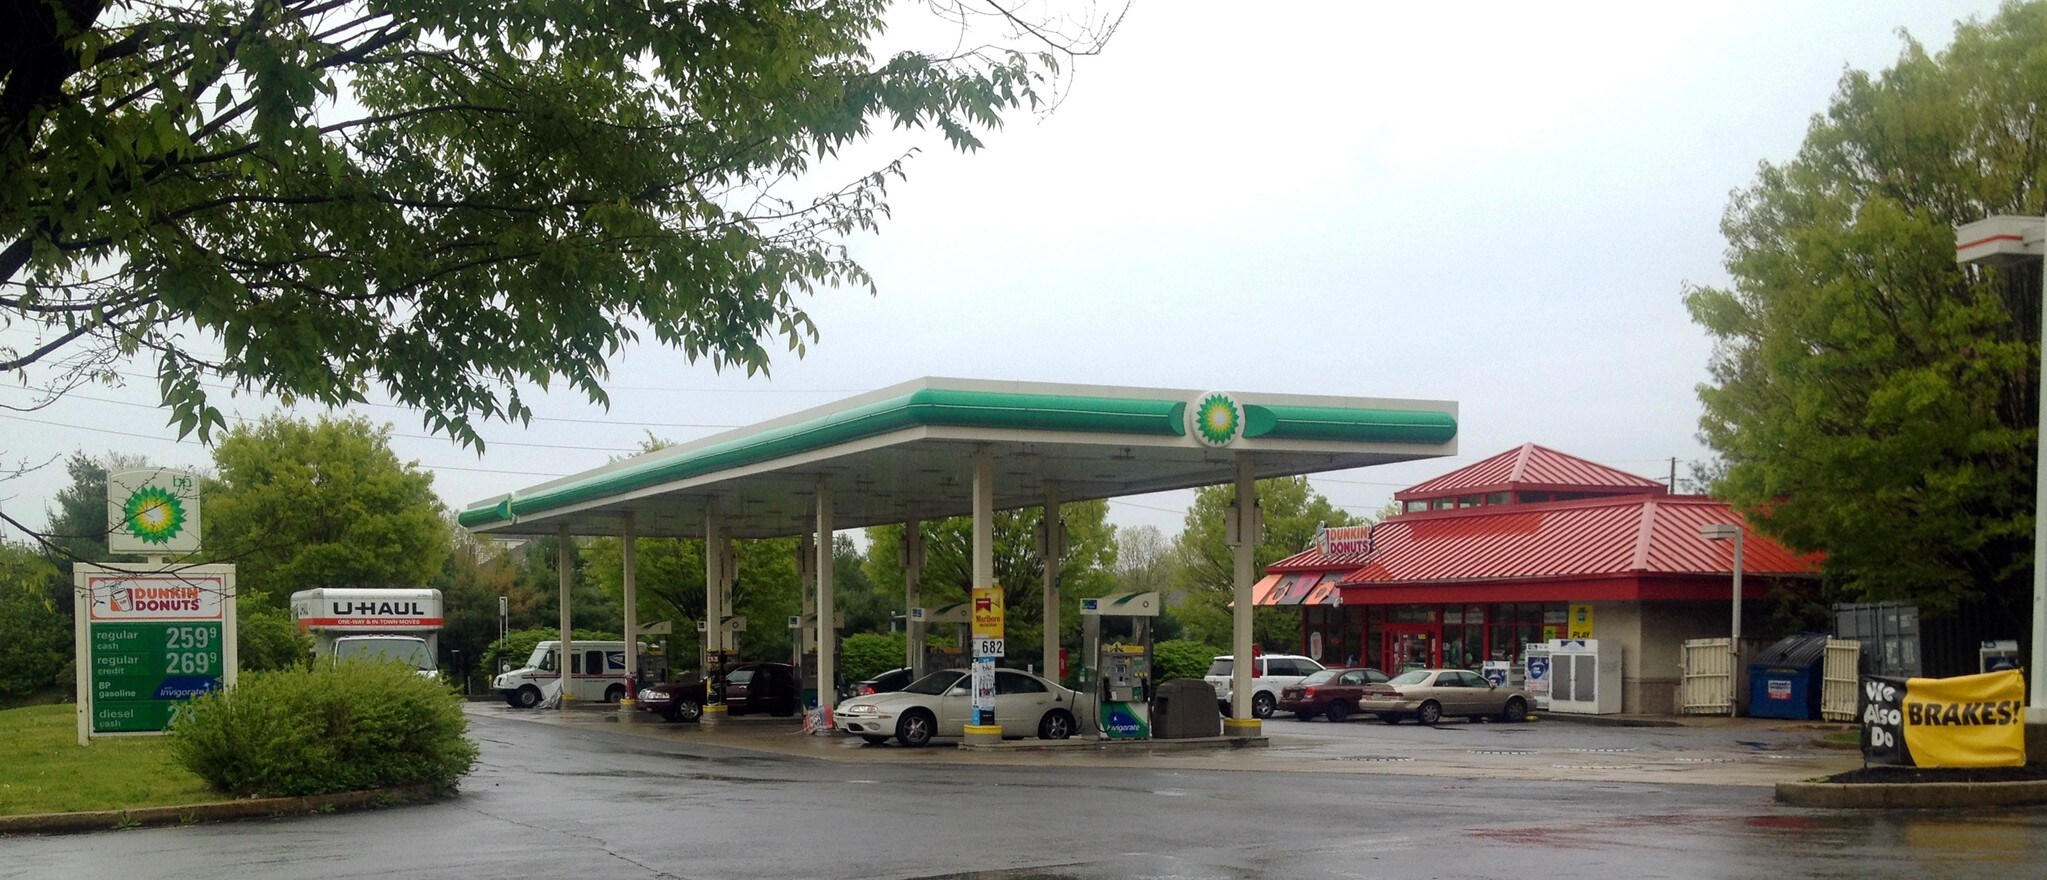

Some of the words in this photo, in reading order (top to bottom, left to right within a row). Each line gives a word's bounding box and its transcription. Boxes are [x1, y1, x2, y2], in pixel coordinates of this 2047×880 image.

[172, 475, 192, 490] bp
[1330, 540, 1369, 554] DONUTS
[135, 599, 200, 612] DONUTS
[333, 602, 424, 615] U-HAUL
[96, 630, 139, 641] regular
[1572, 631, 1591, 639] PLAY
[97, 642, 119, 650] cash
[982, 641, 1003, 654] 682
[97, 655, 139, 666] regular
[98, 667, 125, 675] credit
[98, 681, 111, 690] BP
[98, 690, 136, 699] gasoline
[1865, 681, 1896, 702] We
[99, 709, 134, 719] diesel
[1863, 703, 1901, 726] Also
[1908, 700, 2021, 726] BRAKES!
[99, 719, 121, 728] cash
[1871, 726, 1894, 748] Do
